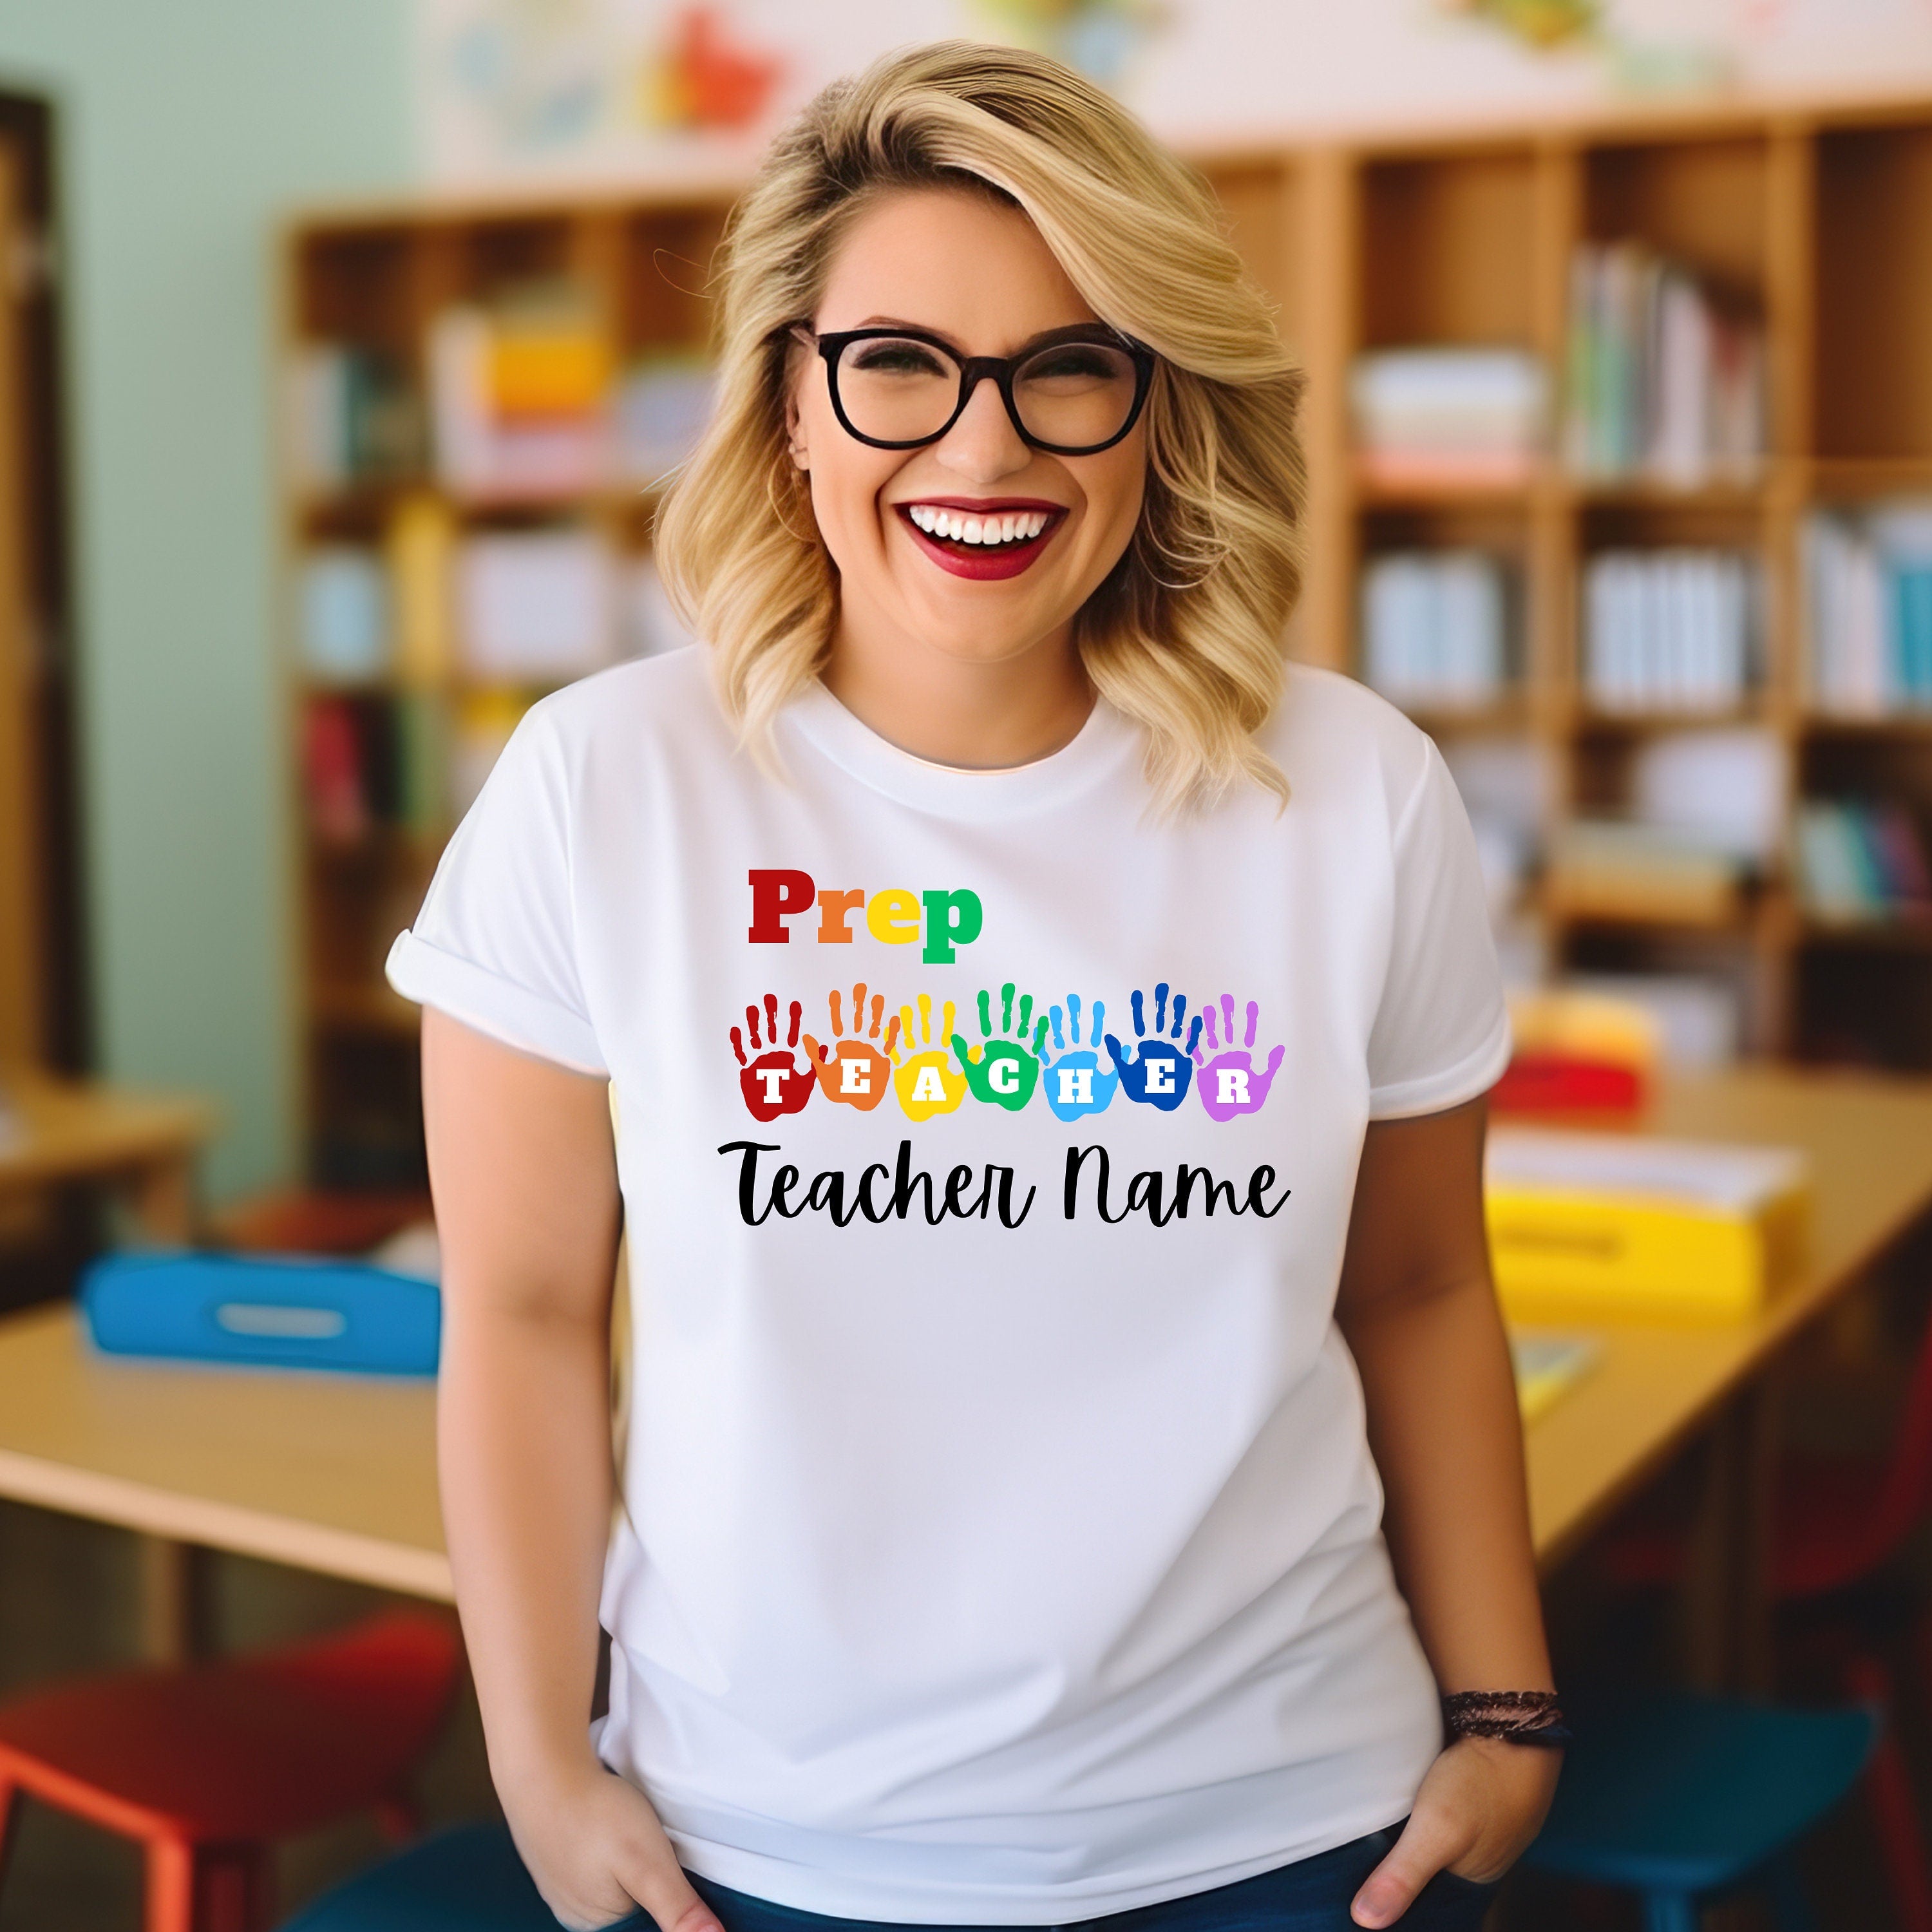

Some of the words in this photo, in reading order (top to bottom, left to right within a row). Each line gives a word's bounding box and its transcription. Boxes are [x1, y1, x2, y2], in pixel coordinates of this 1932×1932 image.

[749, 870, 982, 963] Prep
[756, 1057, 1251, 1104] TEACHER
[717, 1141, 1036, 1228] Teacher
[1065, 1145, 1291, 1227] Name
